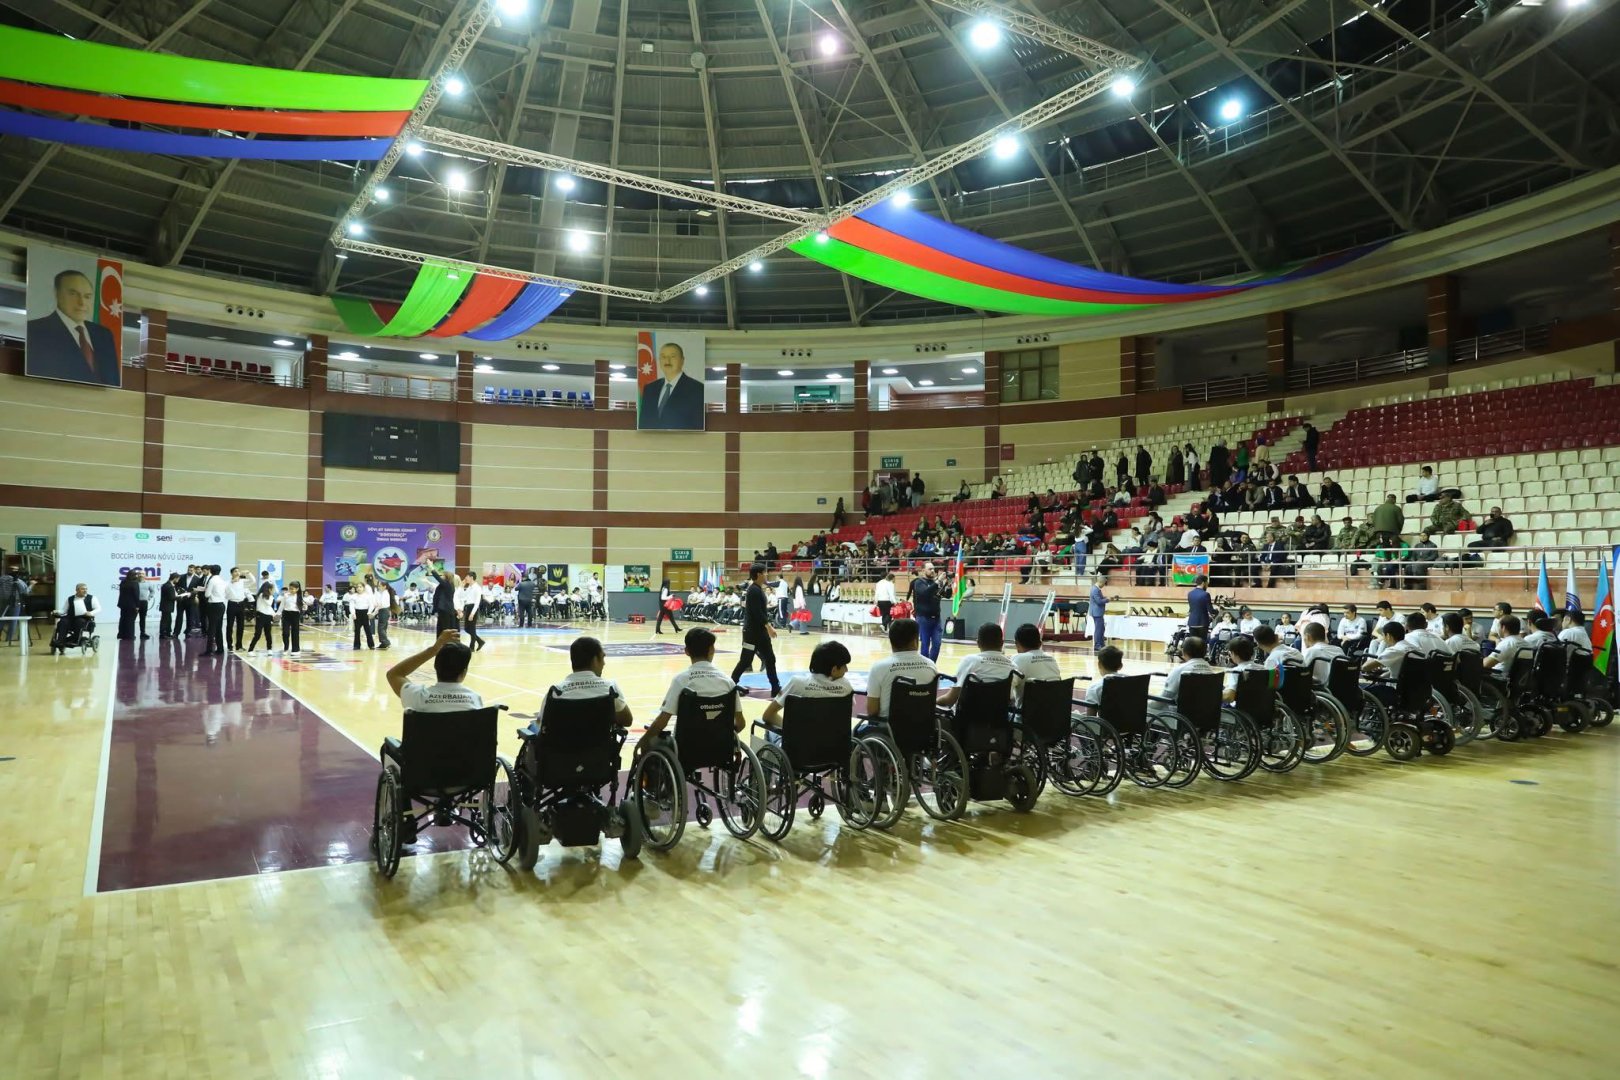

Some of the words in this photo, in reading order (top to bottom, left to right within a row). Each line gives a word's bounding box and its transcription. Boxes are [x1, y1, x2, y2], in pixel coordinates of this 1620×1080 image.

[156, 534, 173, 542] seni
[135, 552, 157, 560] İDMAN
[157, 552, 176, 561] NÖVÜ
